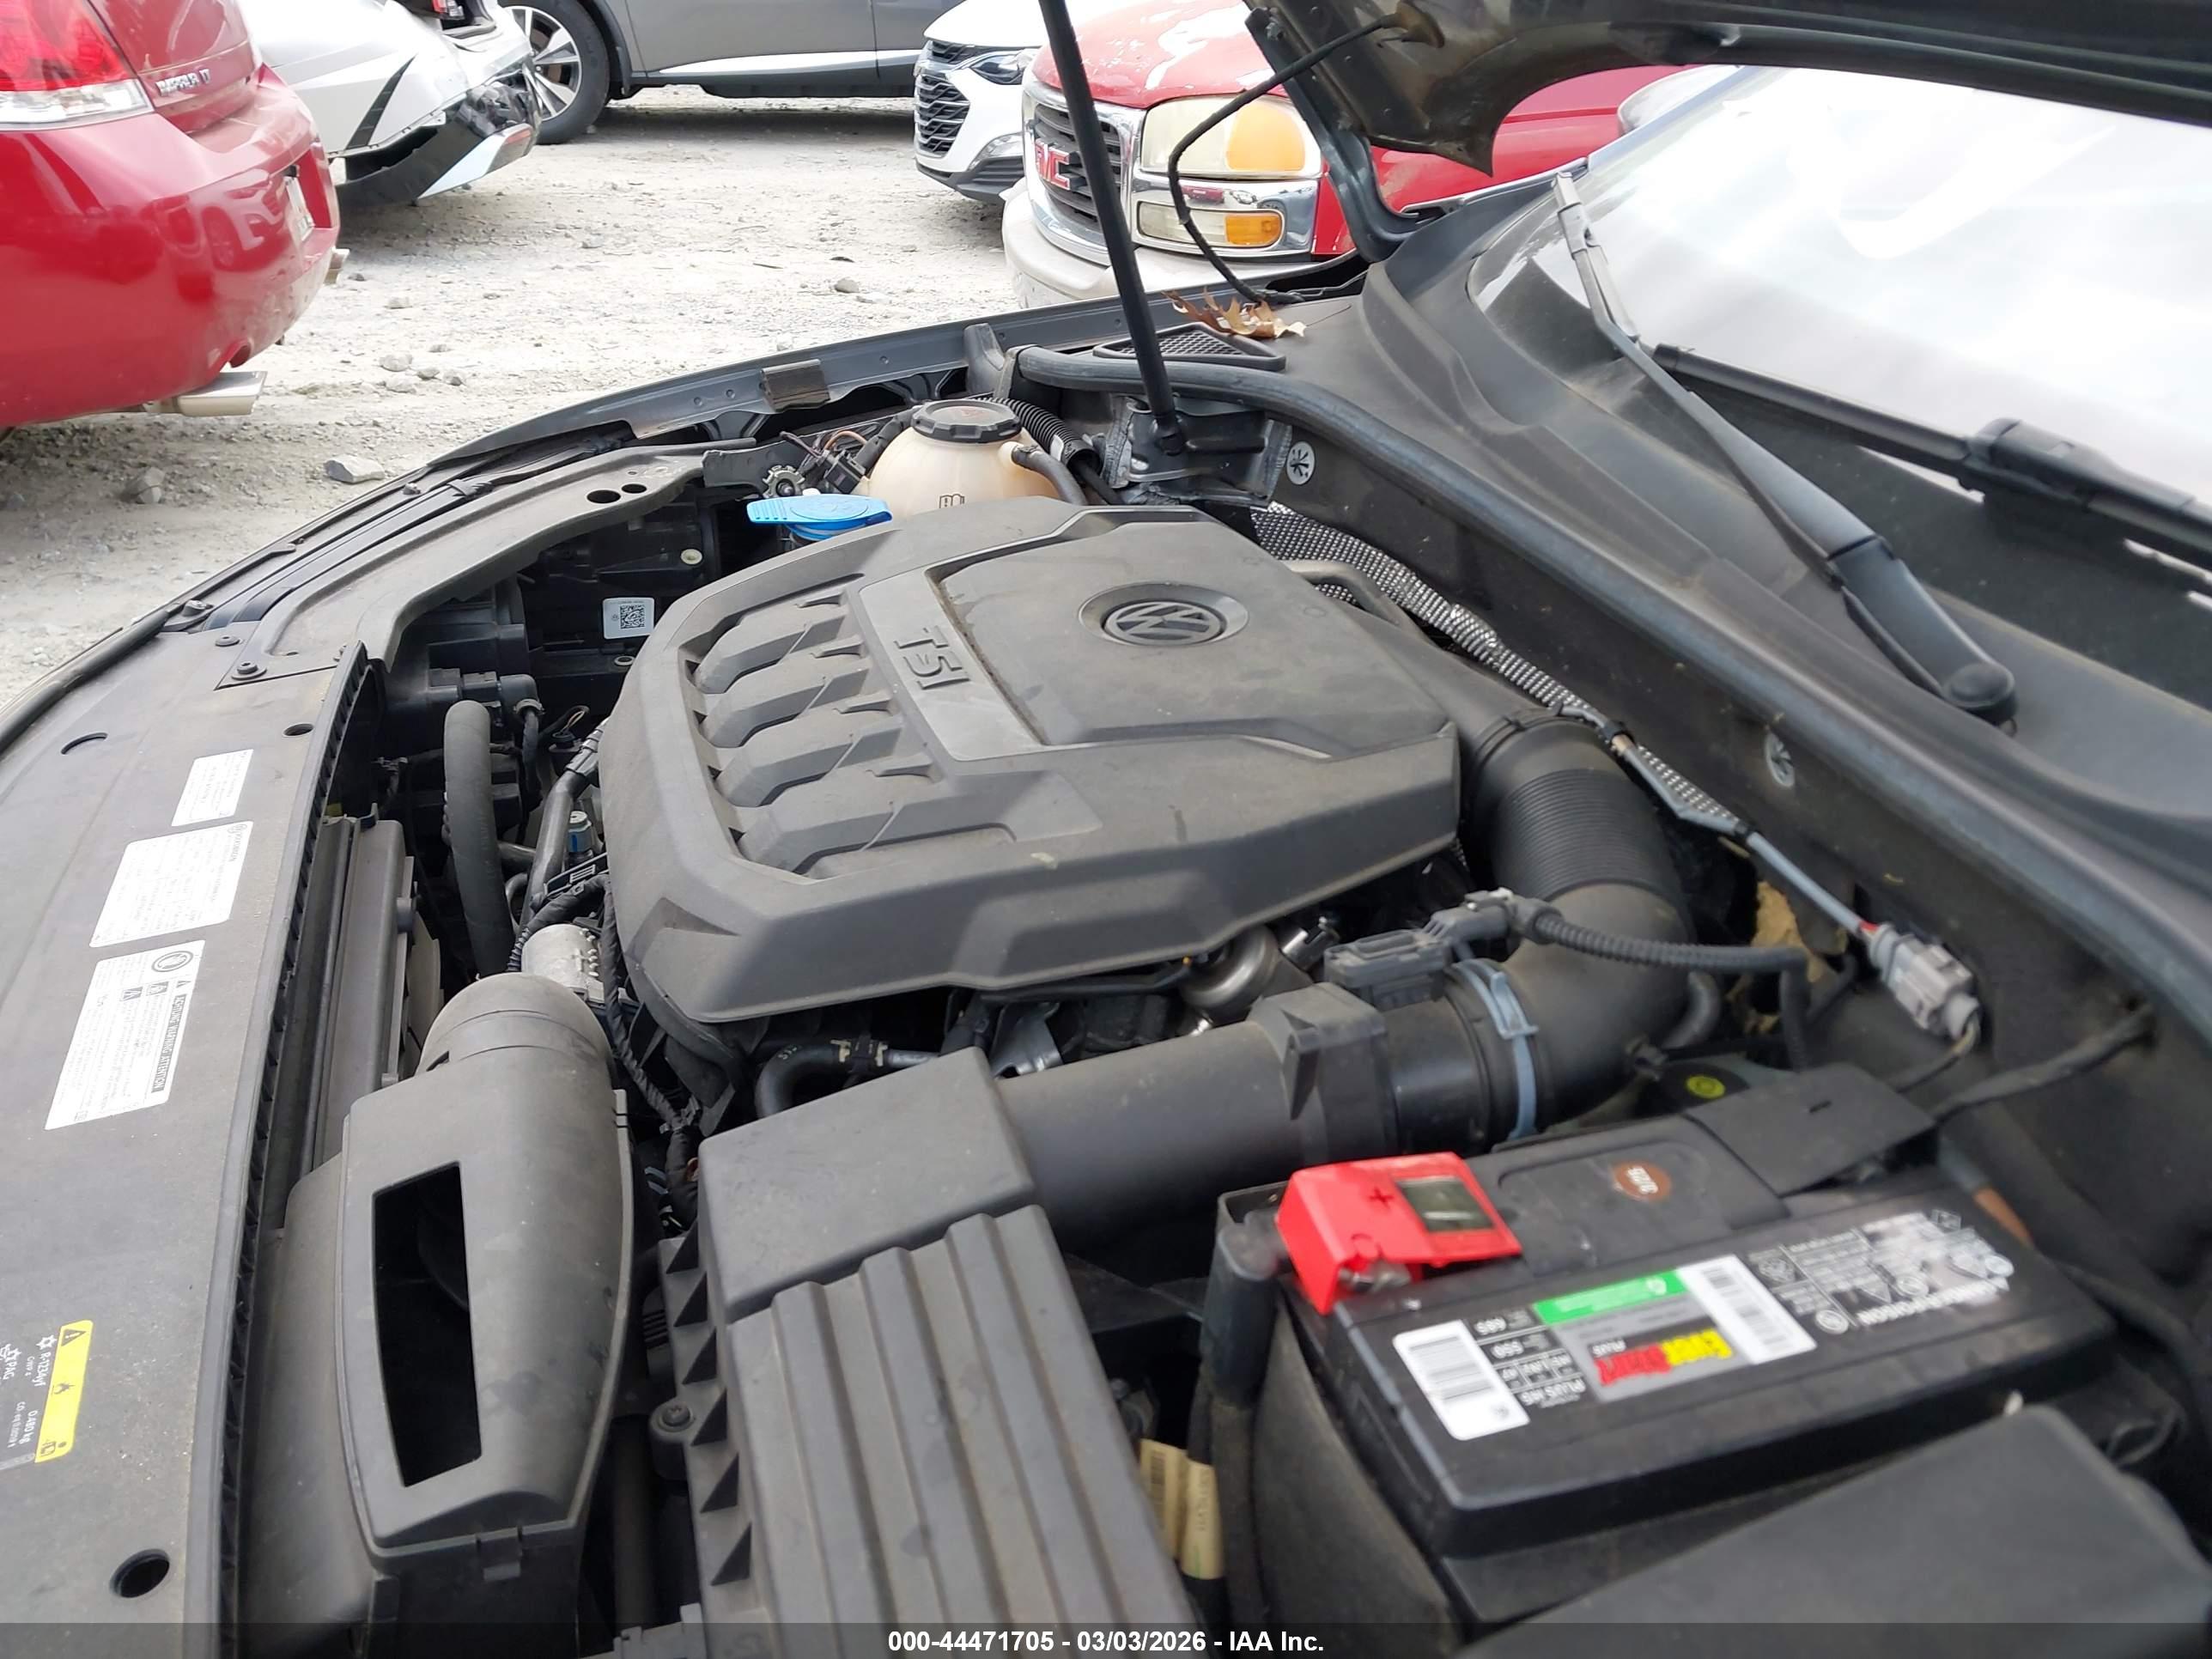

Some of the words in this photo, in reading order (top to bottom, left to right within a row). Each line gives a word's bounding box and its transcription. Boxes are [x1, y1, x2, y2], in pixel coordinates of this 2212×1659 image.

[893, 624, 971, 690] TSI
[168, 996, 186, 1024] ACHTUNG
[161, 1025, 179, 1054] WARNING
[152, 1055, 172, 1089] ATTENTION
[3, 1360, 17, 1380] PAG
[32, 1352, 52, 1386] R-1234yf
[1545, 1378, 1586, 1399] PLUS
[19, 1431, 34, 1444] kg
